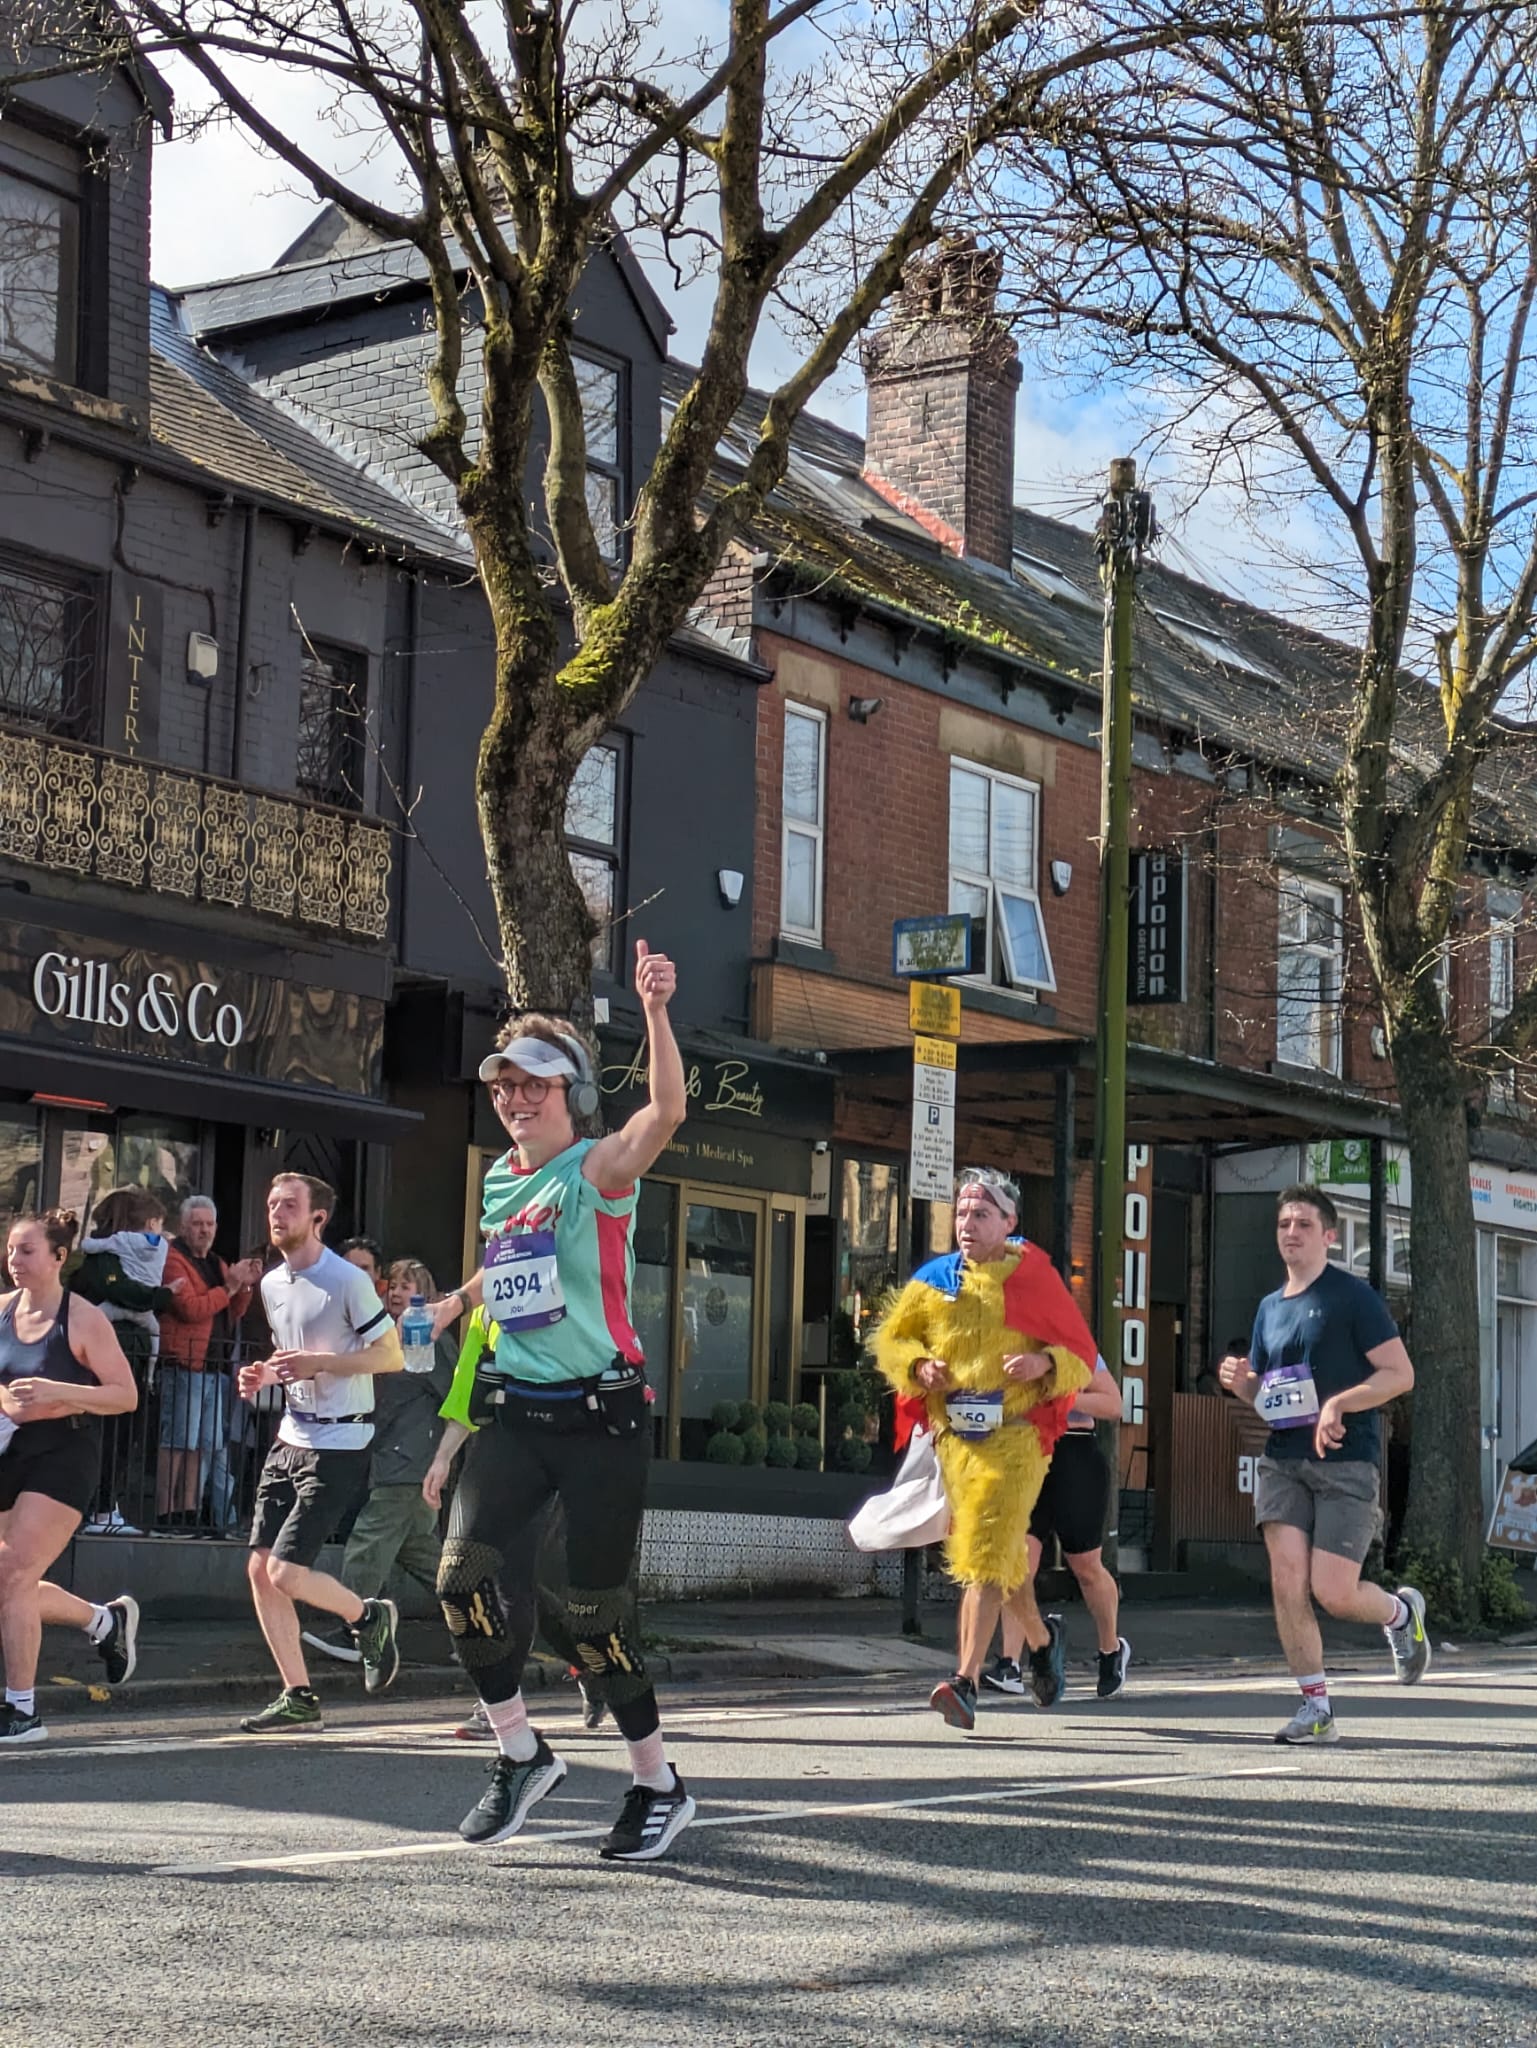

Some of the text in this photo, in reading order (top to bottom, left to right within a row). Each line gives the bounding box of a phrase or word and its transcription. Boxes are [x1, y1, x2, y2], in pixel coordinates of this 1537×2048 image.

[33, 952, 242, 1047] Gills & Co
[705, 1061, 767, 1117] Beauty
[930, 1107, 939, 1123] P
[702, 1143, 736, 1162] Medical
[737, 1152, 754, 1167] Spa
[493, 1272, 542, 1301] 2394
